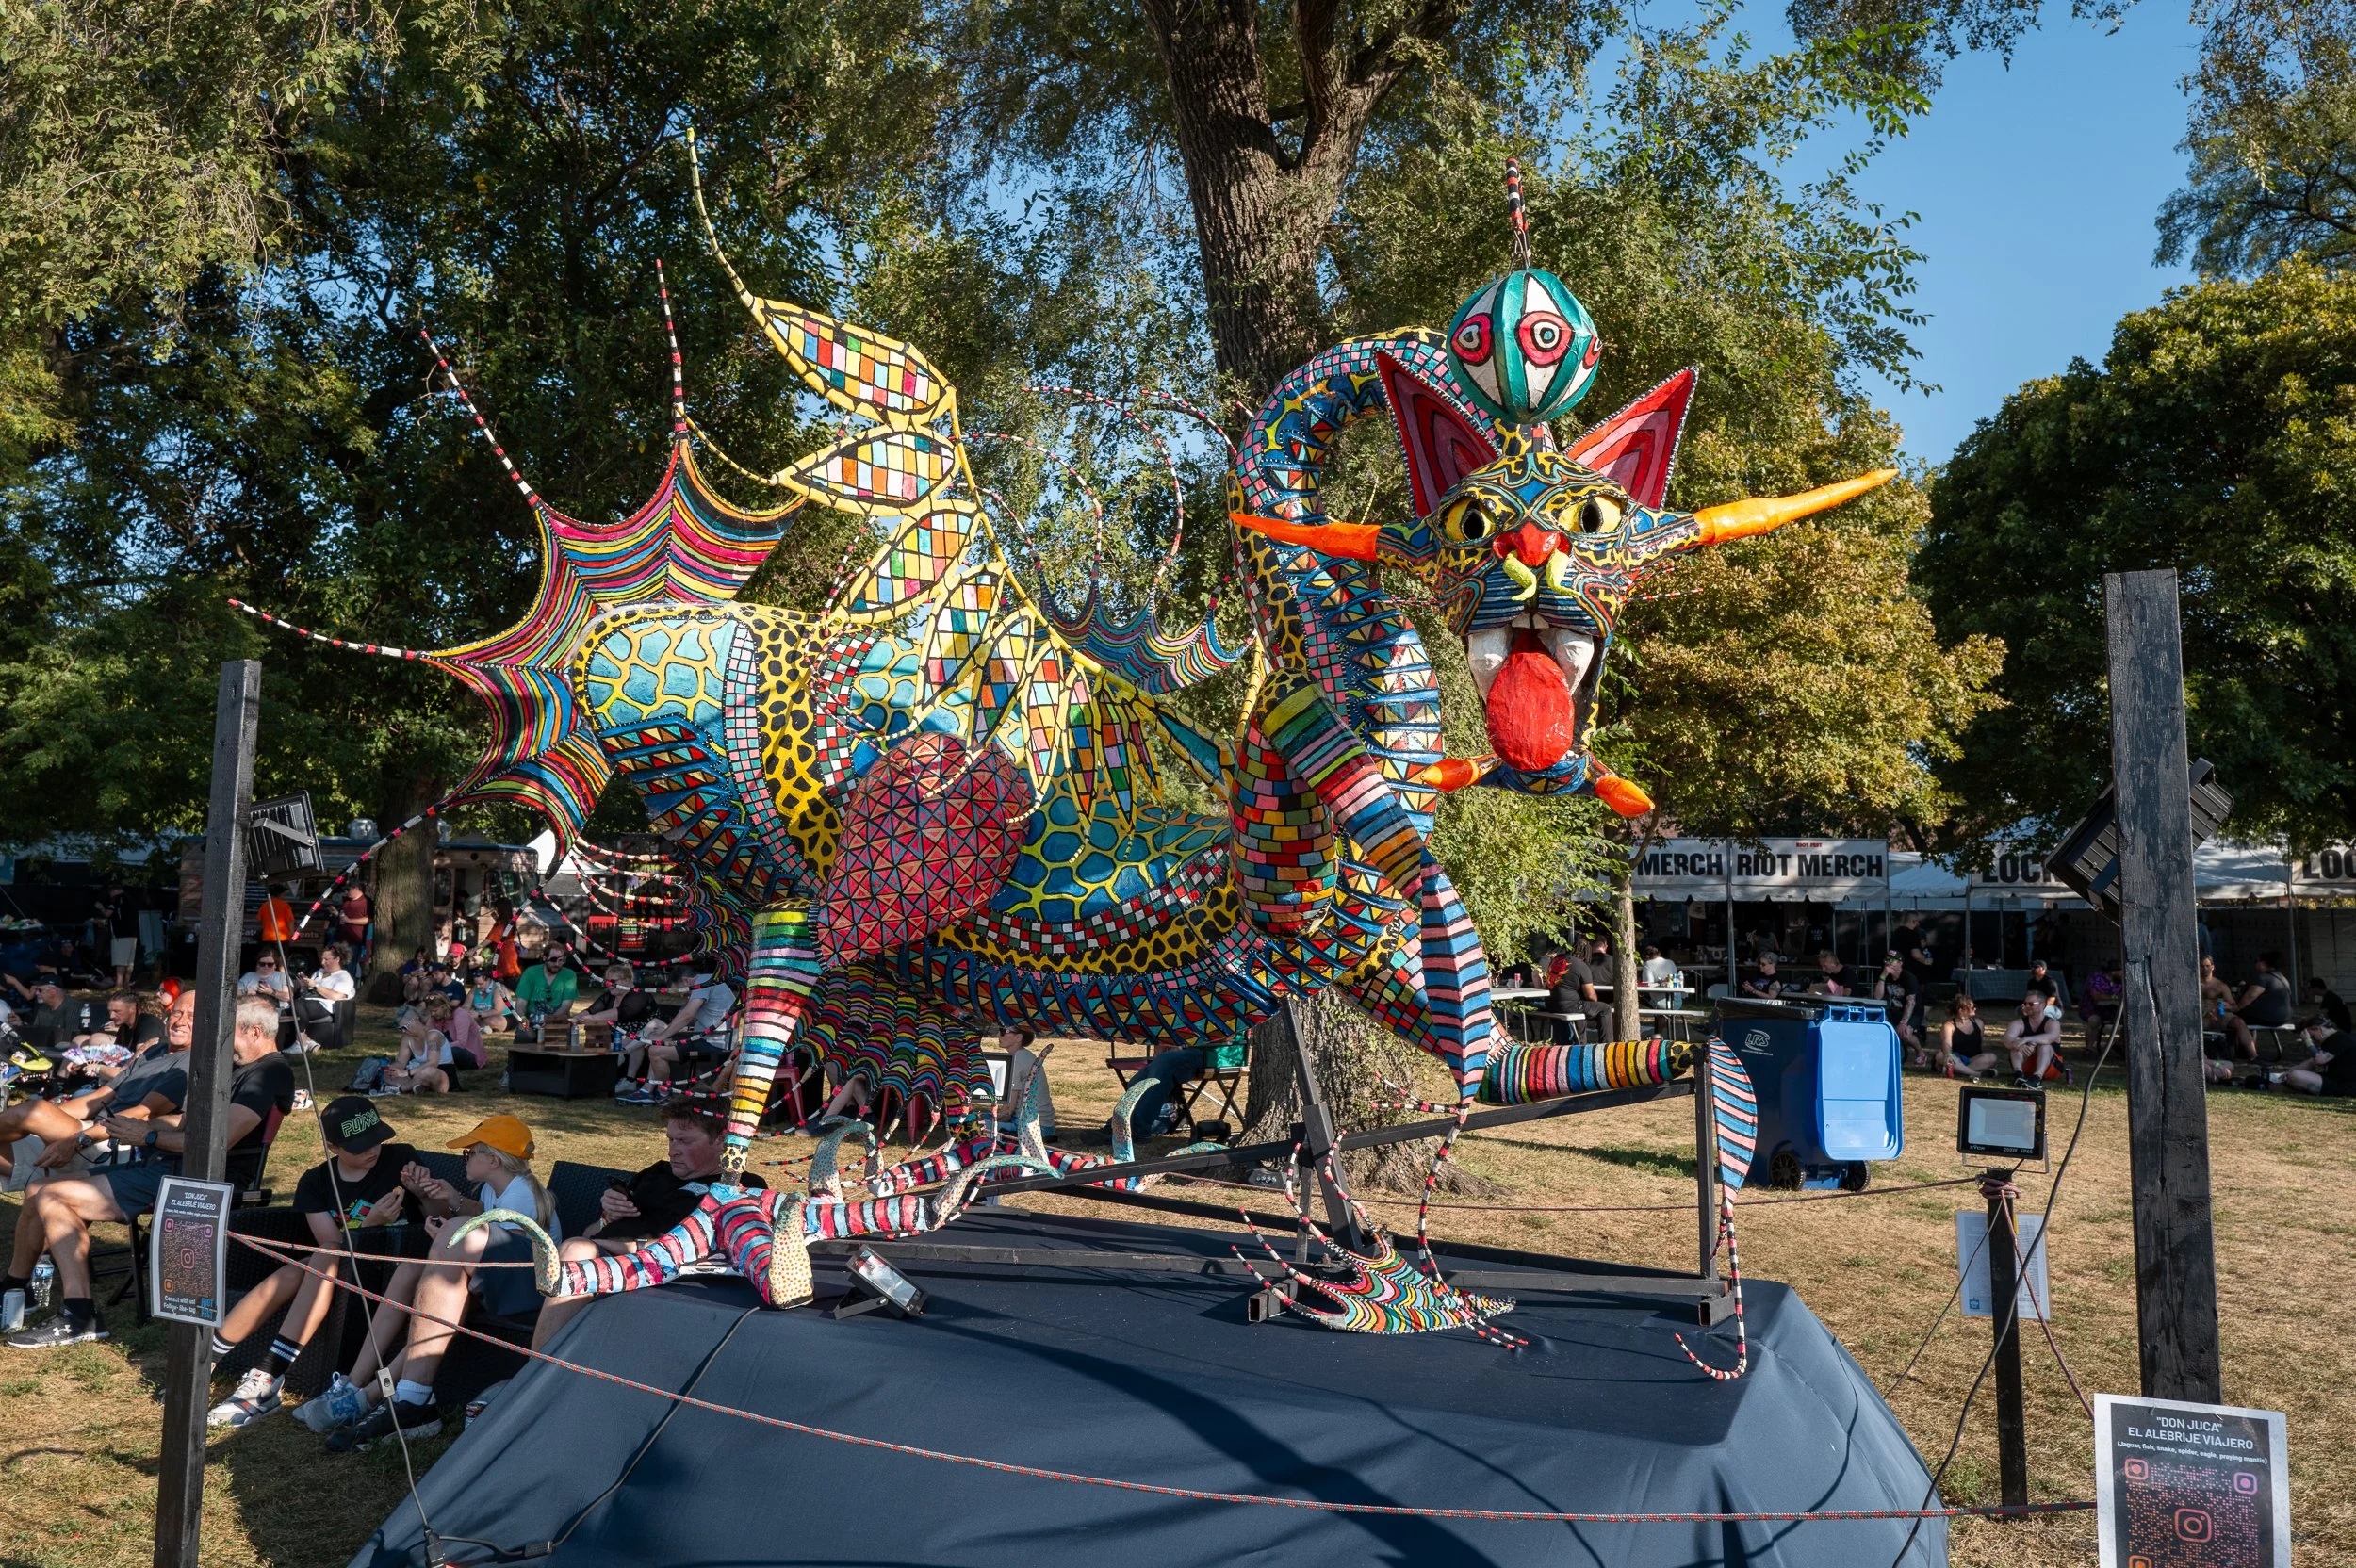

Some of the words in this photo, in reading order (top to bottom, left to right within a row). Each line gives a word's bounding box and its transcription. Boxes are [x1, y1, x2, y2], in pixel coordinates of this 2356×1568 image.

[1637, 853, 1724, 876] MERCH
[1737, 853, 1792, 877] RIOT
[1797, 854, 1883, 877] MERCH
[340, 1108, 380, 1138] PUMA
[2156, 1416, 2185, 1429] "DON
[2186, 1420, 2223, 1433] JUCA"
[2128, 1427, 2144, 1438] EL
[2144, 1429, 2201, 1444] ALEBRIJE
[2202, 1434, 2254, 1450] VIAJERO
[2142, 1443, 2156, 1451] fish,
